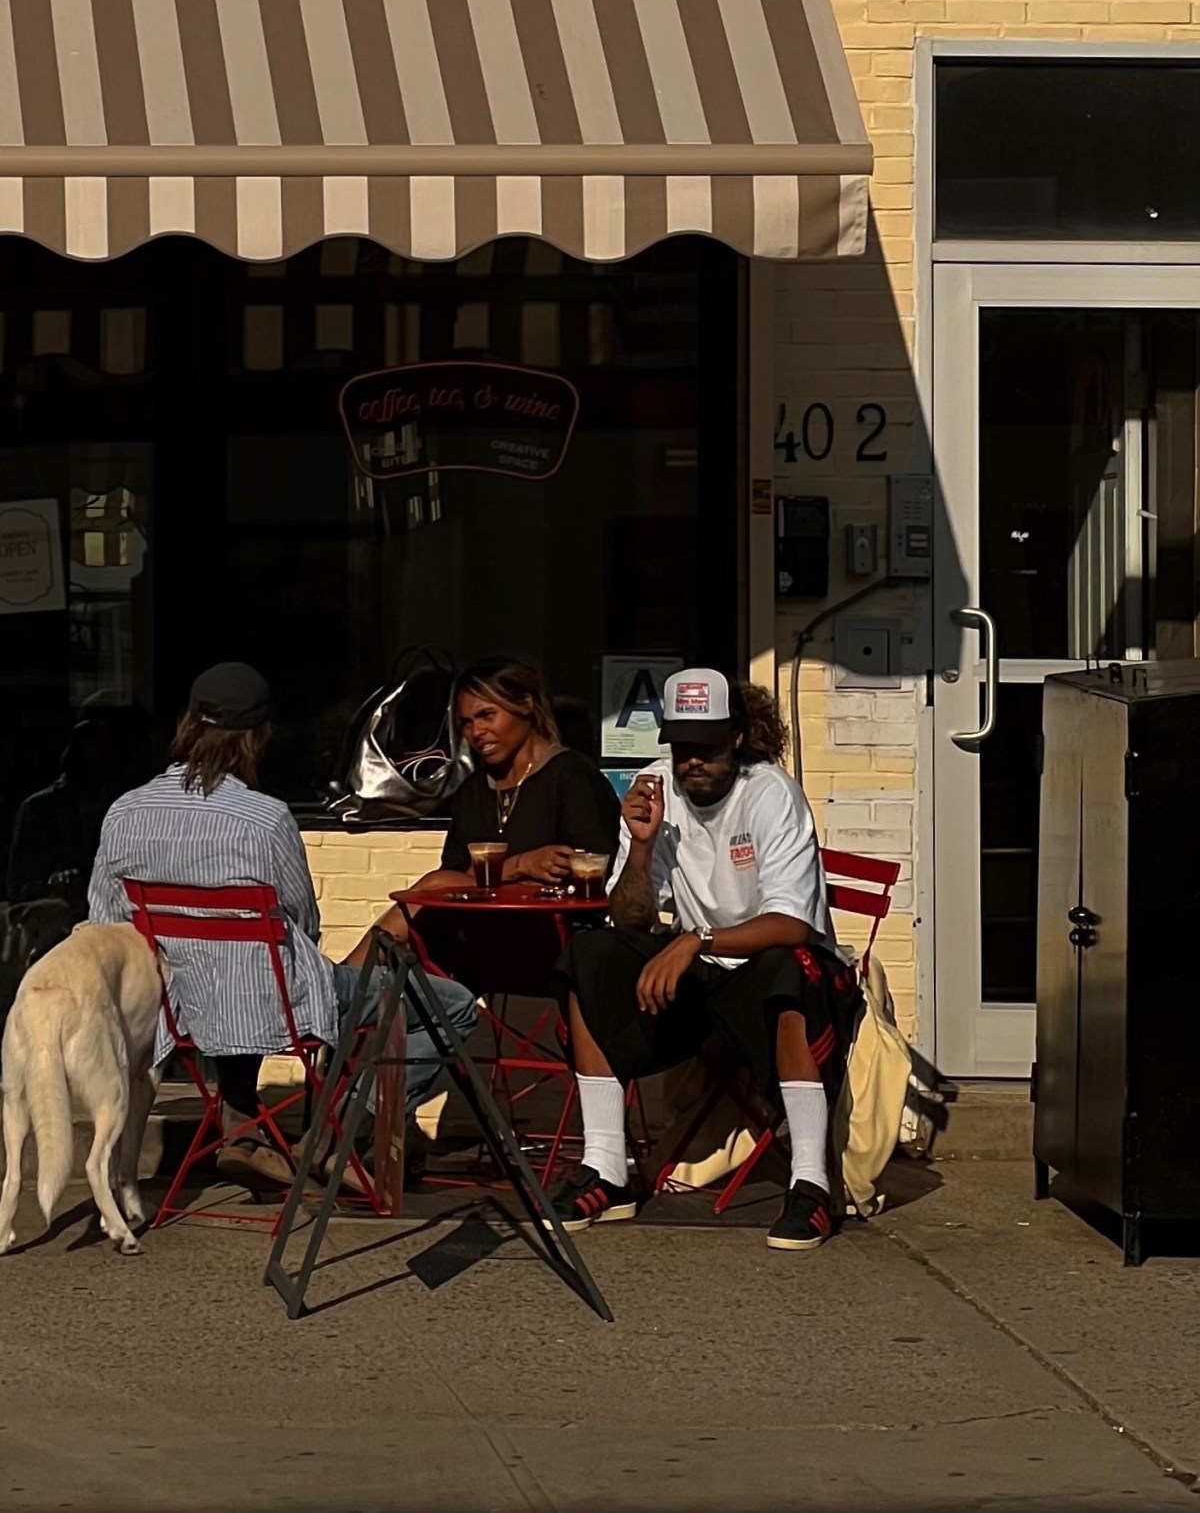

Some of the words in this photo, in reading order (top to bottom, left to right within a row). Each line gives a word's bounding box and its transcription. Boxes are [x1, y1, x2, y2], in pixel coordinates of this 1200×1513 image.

[473, 385, 499, 409] &
[503, 393, 561, 421] wine
[490, 440, 551, 460] CREATIVE
[498, 454, 539, 471] SPACE
[615, 669, 662, 728] A
